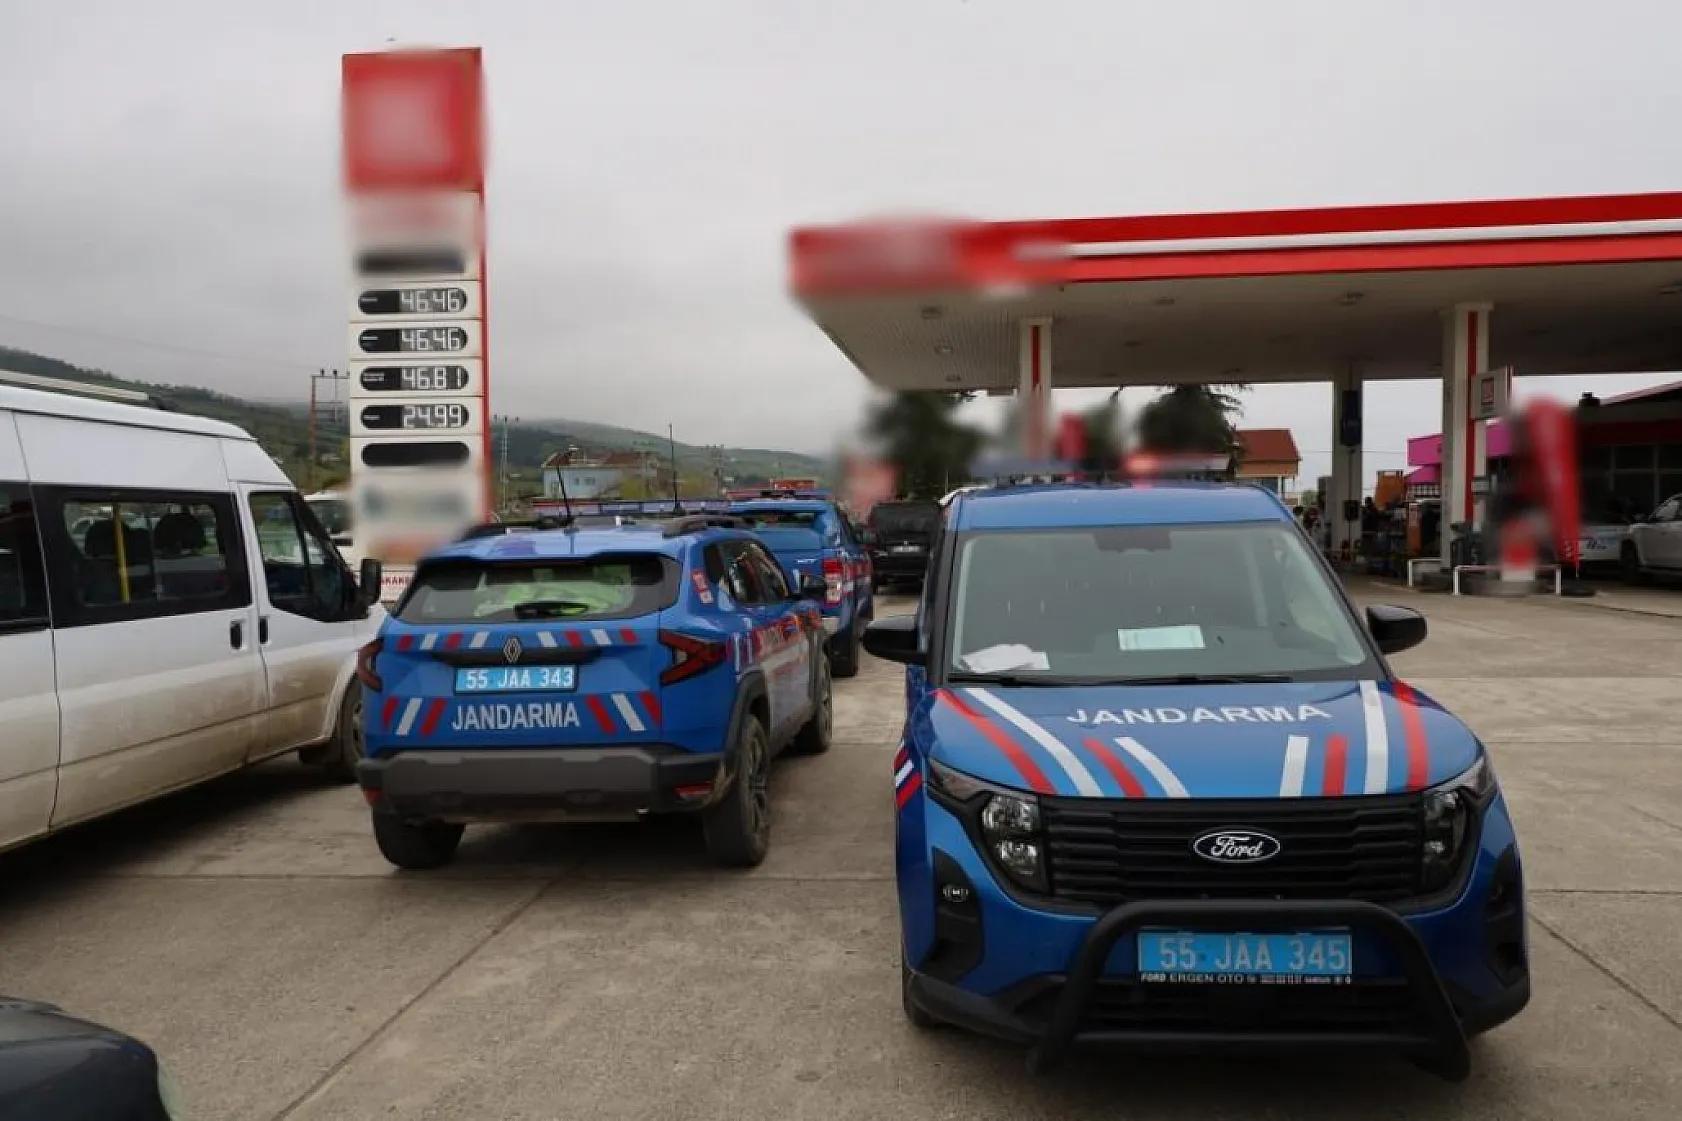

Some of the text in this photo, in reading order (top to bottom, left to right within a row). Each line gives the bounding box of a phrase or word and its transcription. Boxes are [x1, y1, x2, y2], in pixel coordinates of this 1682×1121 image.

[465, 667, 573, 689] 55 JAA 343
[452, 701, 580, 730] JANDARMA
[1066, 705, 1333, 725] JANDARMA
[1210, 836, 1265, 858] Ford
[1159, 938, 1346, 970] 55 JAA 345
[1140, 973, 1166, 982] FORD
[1217, 974, 1245, 984] OTO
